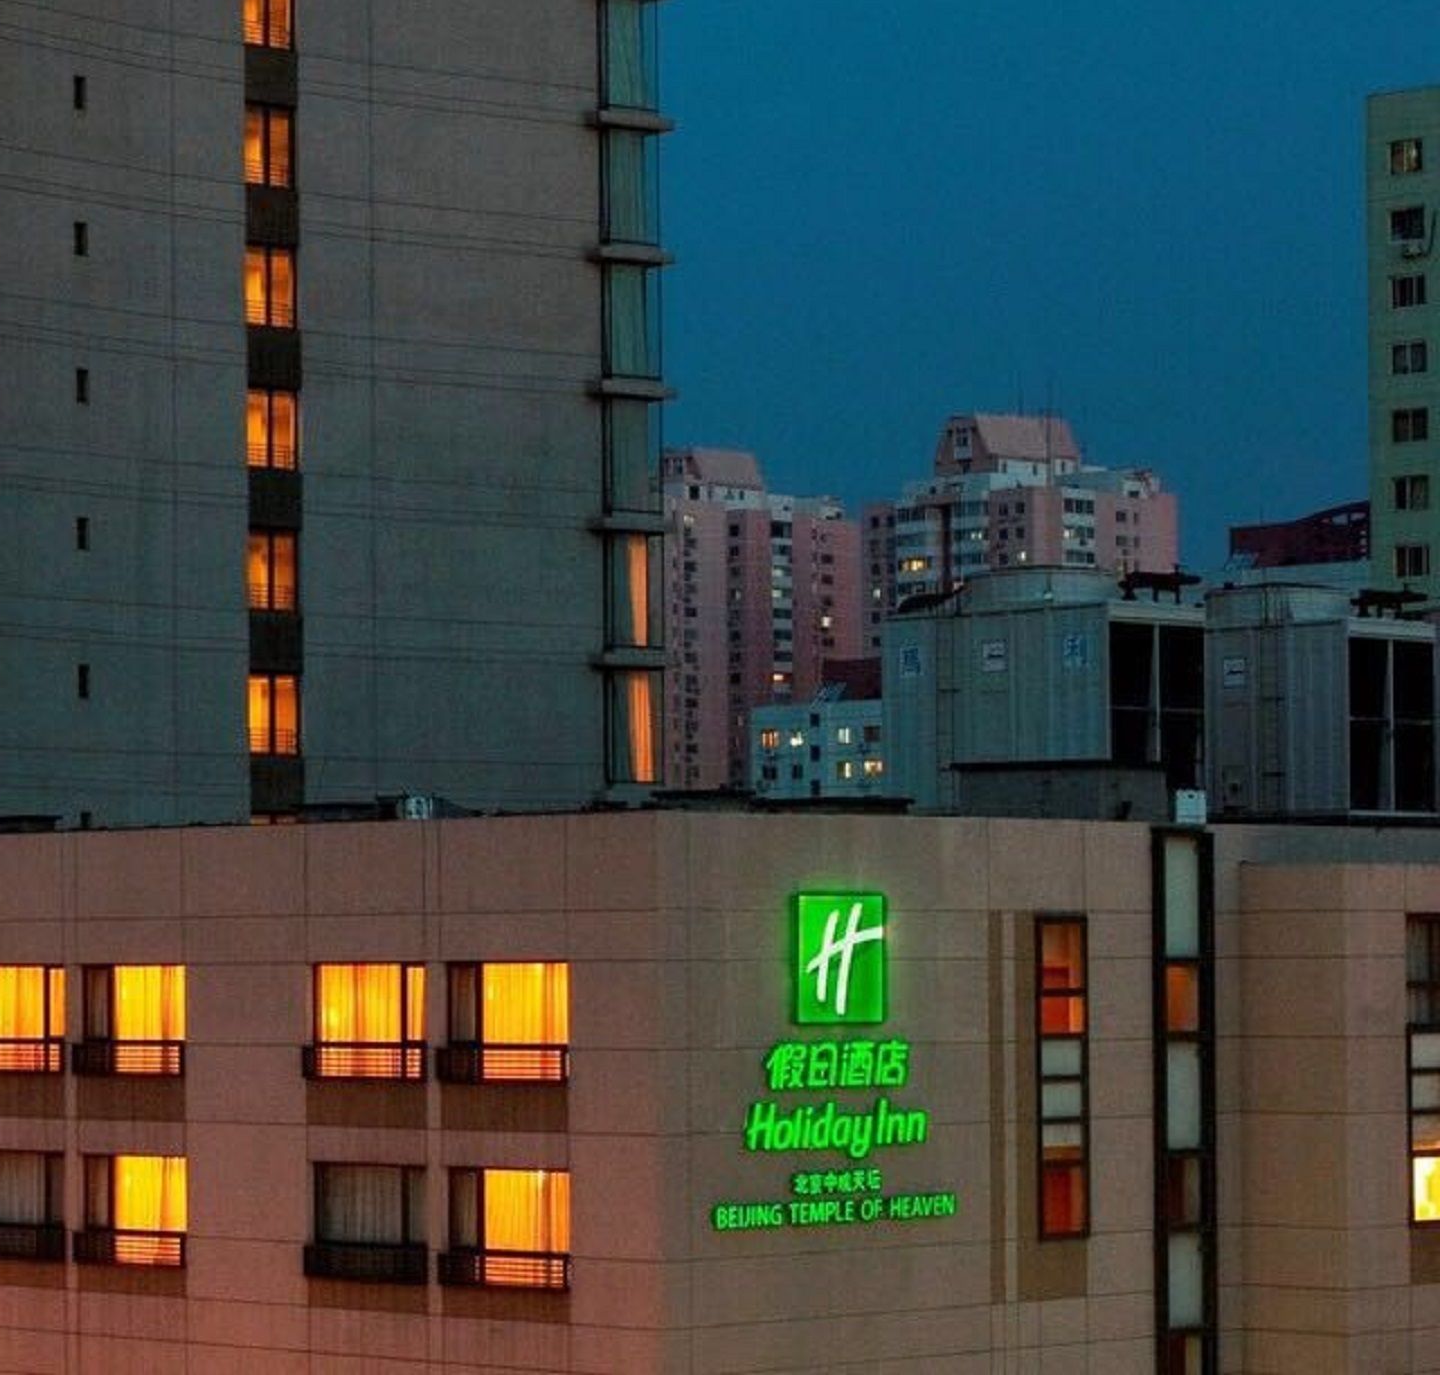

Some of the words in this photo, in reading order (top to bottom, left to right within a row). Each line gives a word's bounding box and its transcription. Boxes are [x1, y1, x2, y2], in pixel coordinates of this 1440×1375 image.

[766, 1040, 909, 1090] 假日酒店
[747, 1101, 873, 1158] Holiday
[877, 1097, 926, 1145] Inn
[716, 1204, 783, 1230] BEIJING
[789, 1201, 854, 1225] TEMPLE
[861, 1199, 883, 1220] OF
[889, 1194, 956, 1218] HEAVEN
